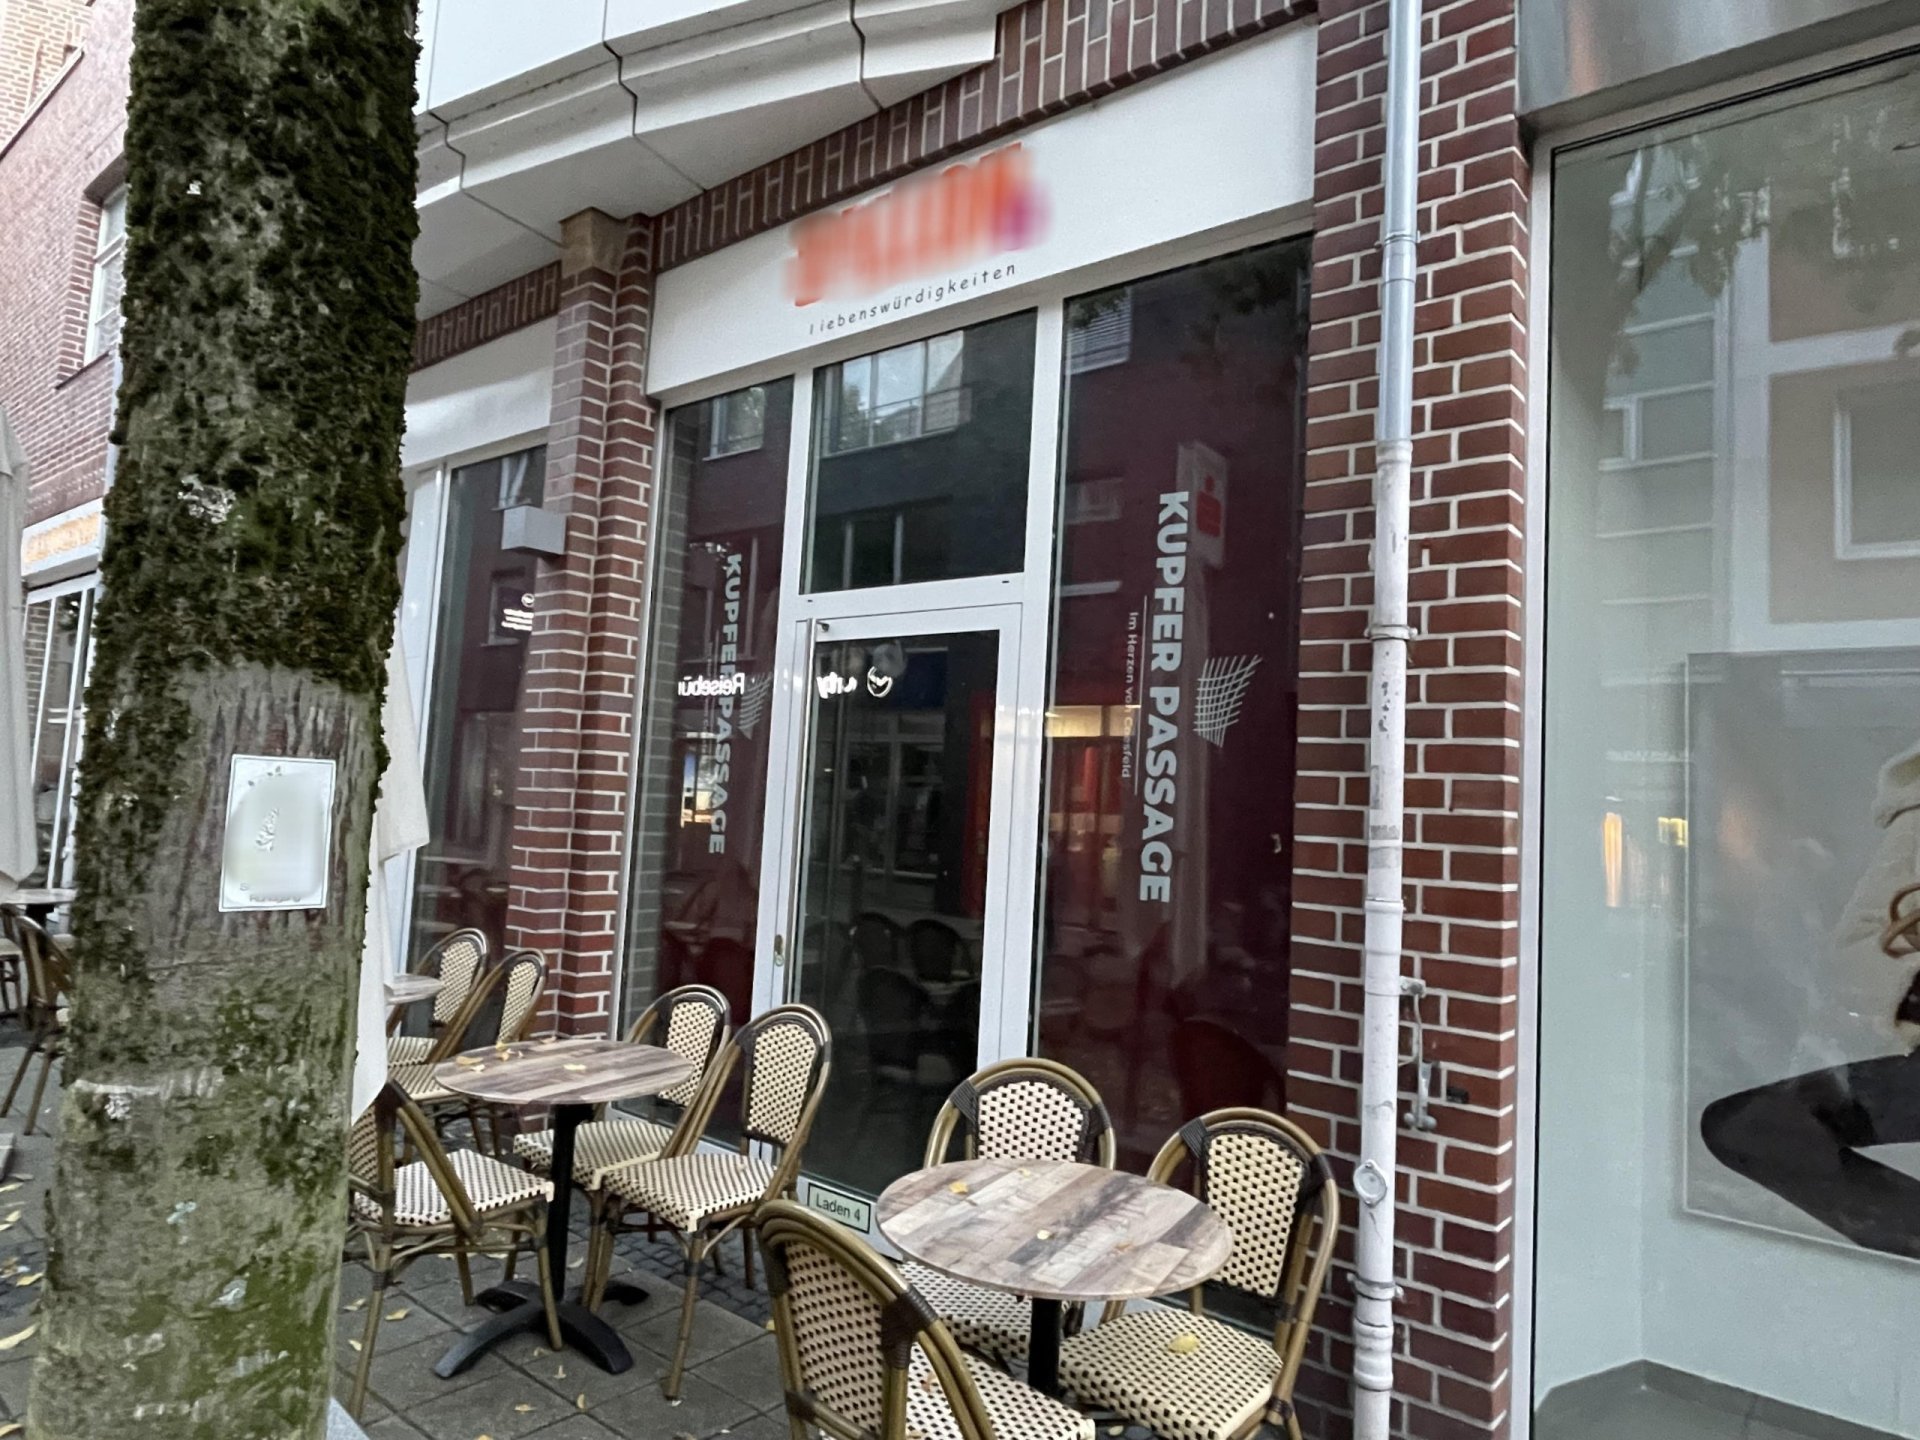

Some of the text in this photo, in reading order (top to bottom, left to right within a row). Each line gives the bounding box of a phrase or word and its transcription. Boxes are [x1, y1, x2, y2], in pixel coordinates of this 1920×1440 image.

[809, 263, 1015, 334] liebenswürdigkeiten
[1128, 611, 1139, 630] Im
[1125, 634, 1138, 683] Herzen
[1140, 491, 1189, 903] KUPFER PASSAGE
[709, 696, 734, 854] PASSAGE
[816, 1193, 860, 1222] Laden 4
